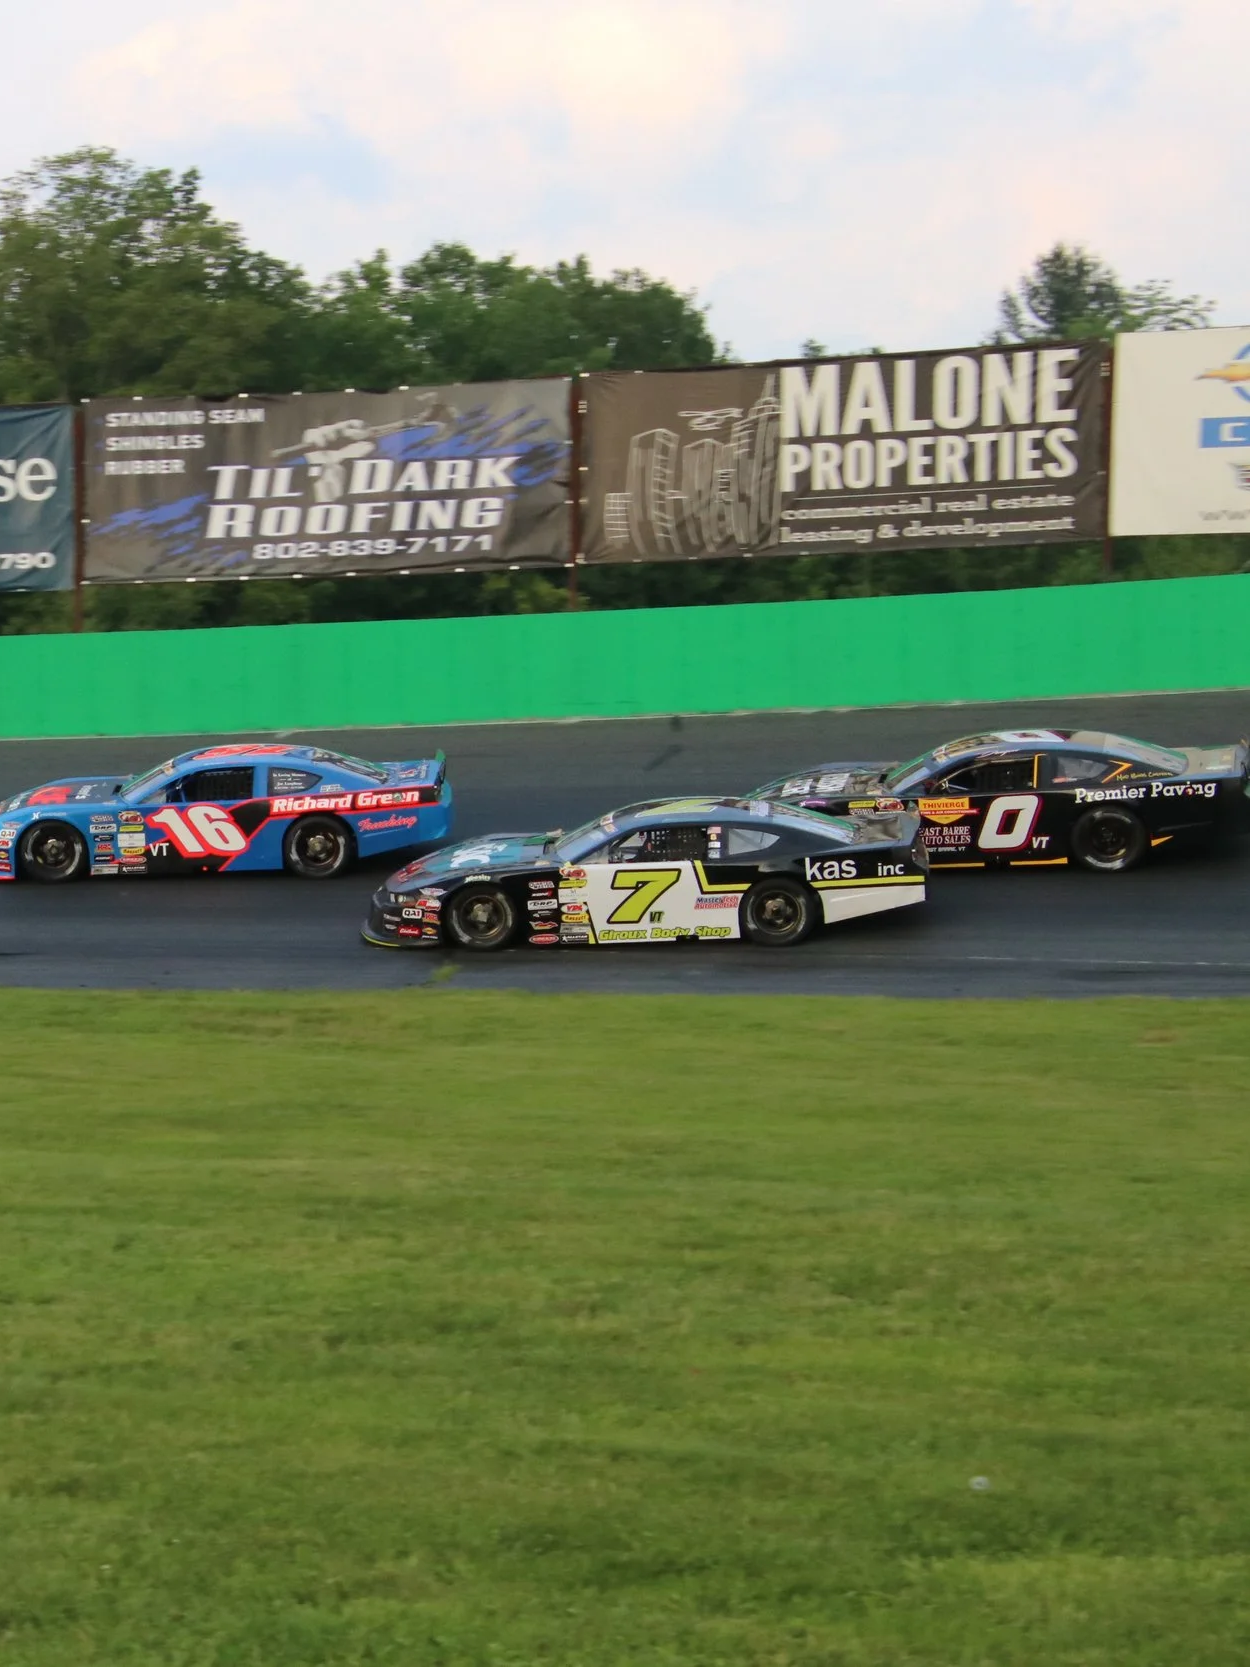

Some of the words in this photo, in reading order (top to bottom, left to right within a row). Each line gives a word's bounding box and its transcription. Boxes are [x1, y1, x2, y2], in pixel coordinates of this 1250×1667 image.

[780, 348, 1080, 438] MALONE
[105, 410, 205, 427] STANDING
[208, 408, 265, 424] SEAM
[105, 434, 205, 451] SHINGLES
[104, 459, 185, 475] RUBBER
[780, 427, 1078, 493] PROPERTIES
[348, 456, 522, 495] DARK
[781, 497, 932, 521] commercial
[936, 496, 987, 514] real
[992, 494, 1075, 511] estate
[205, 497, 505, 539] ROOFING
[780, 526, 873, 545] leasing
[876, 523, 899, 540] &
[903, 515, 1075, 538] development
[253, 535, 493, 560] 802-839-7171
[273, 794, 354, 813] Richard
[1074, 786, 1147, 803] Premier
[149, 803, 248, 855] 16
[942, 826, 971, 836] BARRE
[978, 794, 1040, 850] 0
[150, 843, 169, 856] VT
[944, 835, 971, 845] SALES
[1032, 837, 1050, 848] VT
[805, 857, 858, 881] kas
[877, 862, 905, 877] inc
[607, 868, 682, 924] 7
[404, 910, 421, 918] QA1
[694, 902, 739, 910] Automotive
[650, 911, 664, 923] VT
[599, 929, 648, 942] Giroux
[651, 927, 690, 940] Body
[694, 926, 731, 938] Shop
